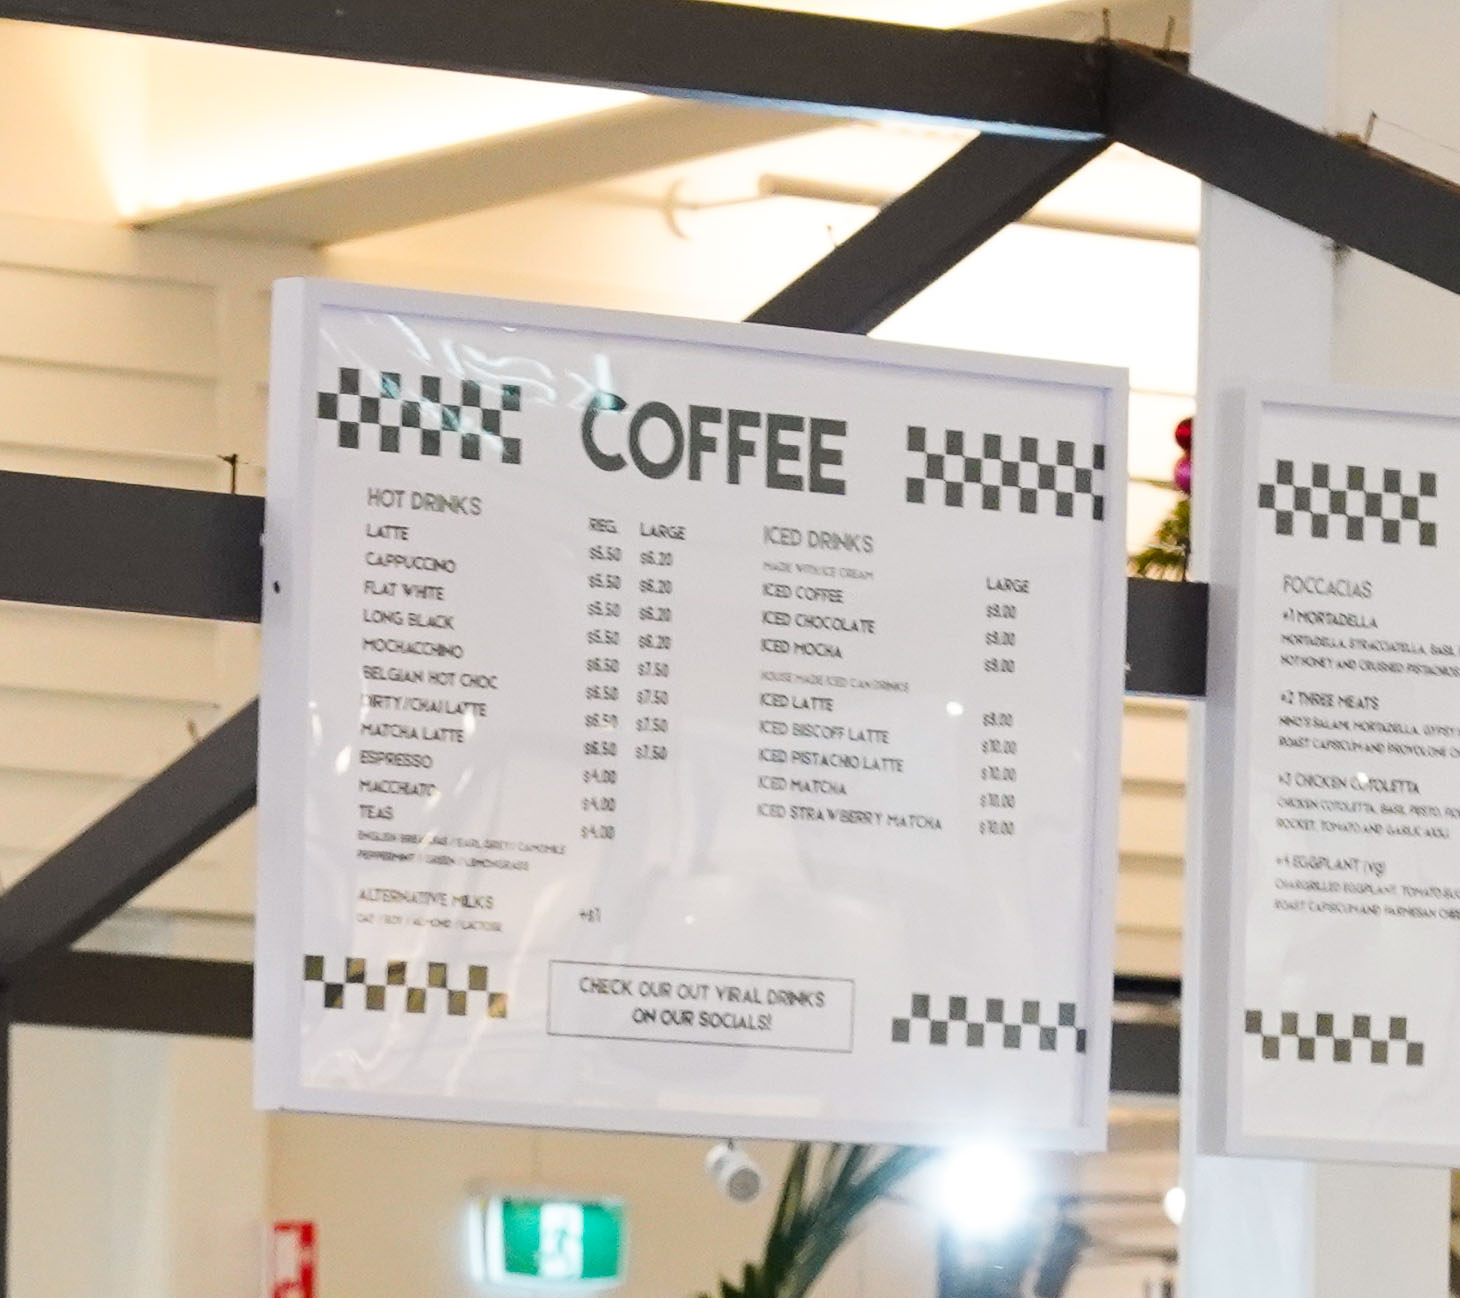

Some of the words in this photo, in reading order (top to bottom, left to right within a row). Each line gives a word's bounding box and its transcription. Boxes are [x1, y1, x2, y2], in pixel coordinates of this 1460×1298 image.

[581, 391, 848, 496] COFFEE
[366, 488, 406, 508] HOT
[410, 490, 482, 516] DRINKS
[366, 524, 409, 541] LATTE
[639, 522, 687, 541] LARGE
[764, 526, 801, 546] ICED
[808, 530, 873, 553] DRINKS
[365, 552, 456, 574] CAPPUCCINO
[364, 581, 397, 598] FLAT
[402, 583, 445, 601] WHITE
[763, 583, 792, 599] ICED
[796, 585, 844, 603] COFFEE
[986, 577, 1030, 594] LARGE
[1282, 575, 1372, 599] FOCCACIAS
[363, 608, 404, 626] LONG
[408, 612, 455, 630] BLACK
[762, 610, 791, 626] ICED
[795, 613, 875, 634] CHOCOLATE
[1297, 611, 1378, 629] MORTADELLA
[761, 638, 789, 654] ICED
[794, 641, 842, 659] MOCHA
[363, 665, 423, 684] BELGIAN
[429, 671, 455, 687] HOT
[459, 672, 499, 690] CHOC
[760, 693, 789, 708] ICED
[792, 696, 833, 712] LATTE
[1297, 691, 1335, 708] THREE
[1338, 695, 1379, 710] MEATS
[360, 722, 418, 741] MATCHA
[422, 726, 464, 744] LATTE
[760, 720, 788, 736] ICED
[792, 722, 844, 740] BISCOFF
[848, 728, 889, 744] LATTE
[360, 750, 433, 769] ESPRESSO
[759, 748, 787, 764] ICED
[791, 751, 859, 769] PISTACHIO
[862, 756, 903, 773] LATTE
[359, 779, 438, 798] MACCHIATO
[758, 775, 787, 791] ICED
[790, 778, 847, 796] MATCHA
[1295, 773, 1346, 791] CHICKEN
[359, 804, 394, 821] TEAS
[757, 803, 786, 819] ICED
[789, 805, 883, 826] STRAWBERRY
[887, 814, 942, 831] MATCHA
[1292, 855, 1360, 872] EGGPLANT
[359, 888, 448, 908] ALTERNATIVE
[451, 893, 494, 909] MILKS
[579, 976, 631, 998] CHECK
[639, 980, 672, 999] OUR
[677, 982, 710, 1001] OUT
[714, 984, 762, 1005] VIRAL
[767, 987, 825, 1008] DRINKS
[632, 1007, 657, 1025] ON
[661, 1009, 694, 1027] OUR
[699, 1011, 772, 1030] SOCIALS!
